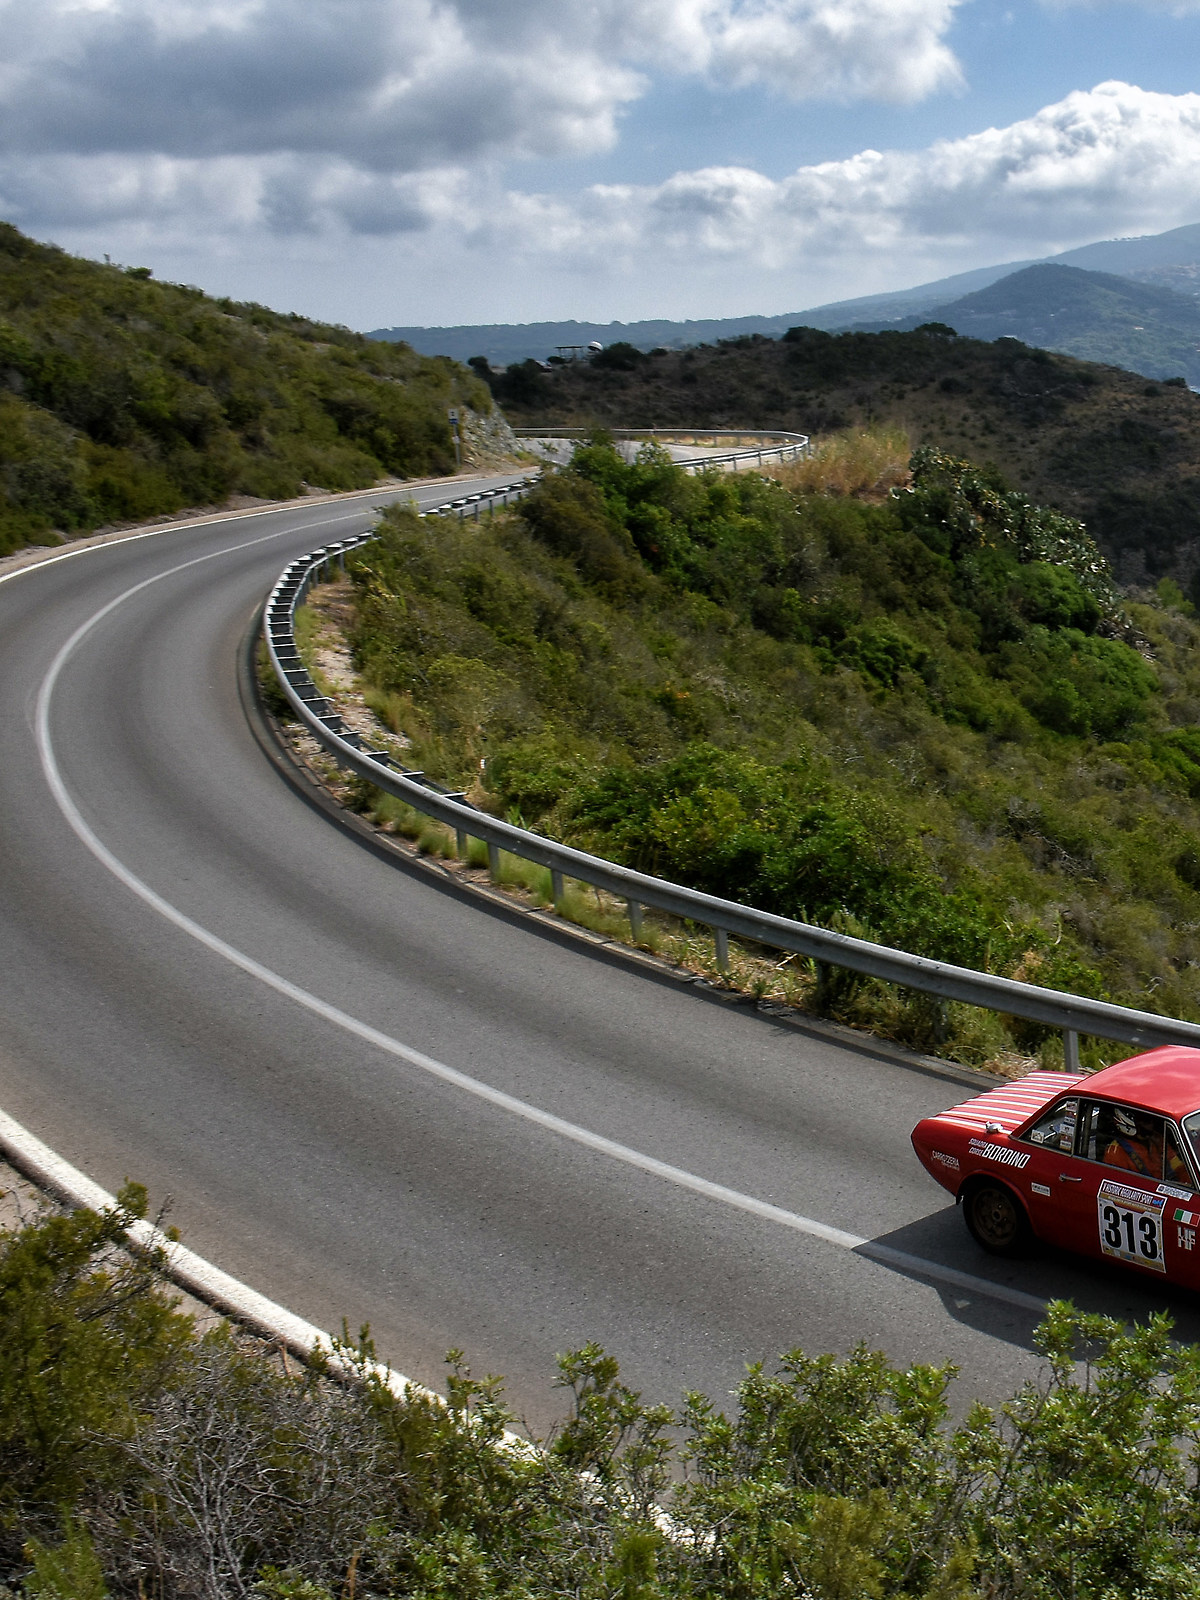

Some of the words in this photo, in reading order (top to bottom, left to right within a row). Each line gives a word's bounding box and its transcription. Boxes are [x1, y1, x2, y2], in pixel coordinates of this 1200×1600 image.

[982, 1143, 1031, 1169] BORDINO
[1141, 1193, 1154, 1205] SPORT
[1103, 1205, 1158, 1260] 313
